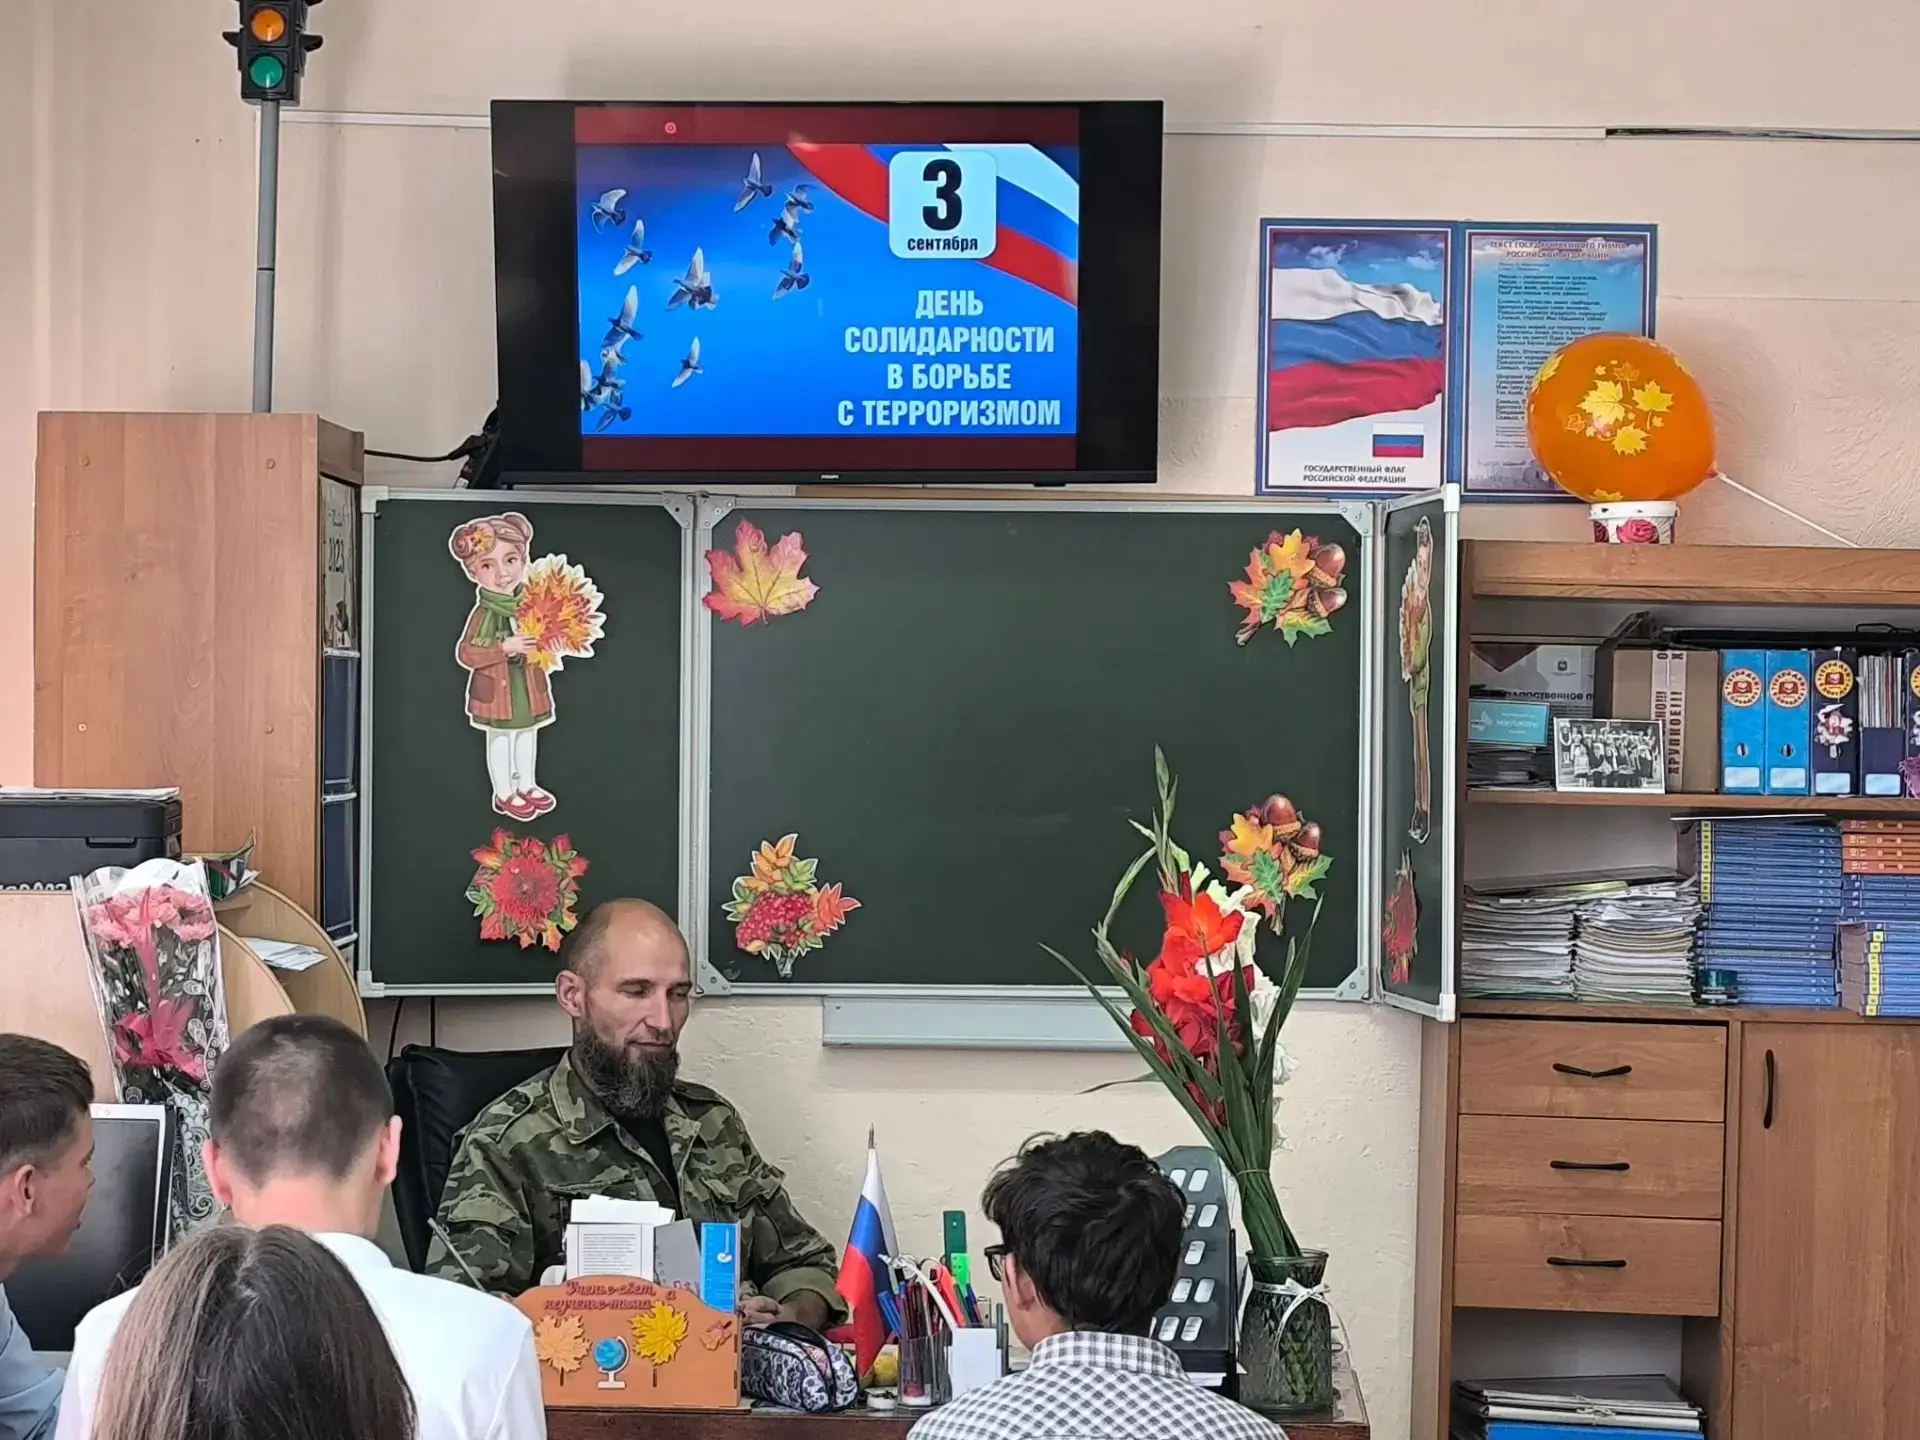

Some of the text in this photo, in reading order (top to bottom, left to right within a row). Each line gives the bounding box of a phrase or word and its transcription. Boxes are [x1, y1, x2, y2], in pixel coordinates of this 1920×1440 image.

[922, 158, 963, 232] 3
[907, 235, 978, 253] сентября
[915, 289, 984, 319] ДЕНЬ
[844, 326, 1055, 356] СОЛИДАРНОСТИ
[887, 363, 1012, 390] В БОРЬБЕ
[837, 399, 1061, 426] С ТЕРРОРИЗМОМ
[1303, 465, 1382, 473] ГОСУДАРСТВЕННЫЙ
[1303, 474, 1406, 484] РОССИЙСКОЙ ФЕДЕРАЦИИ
